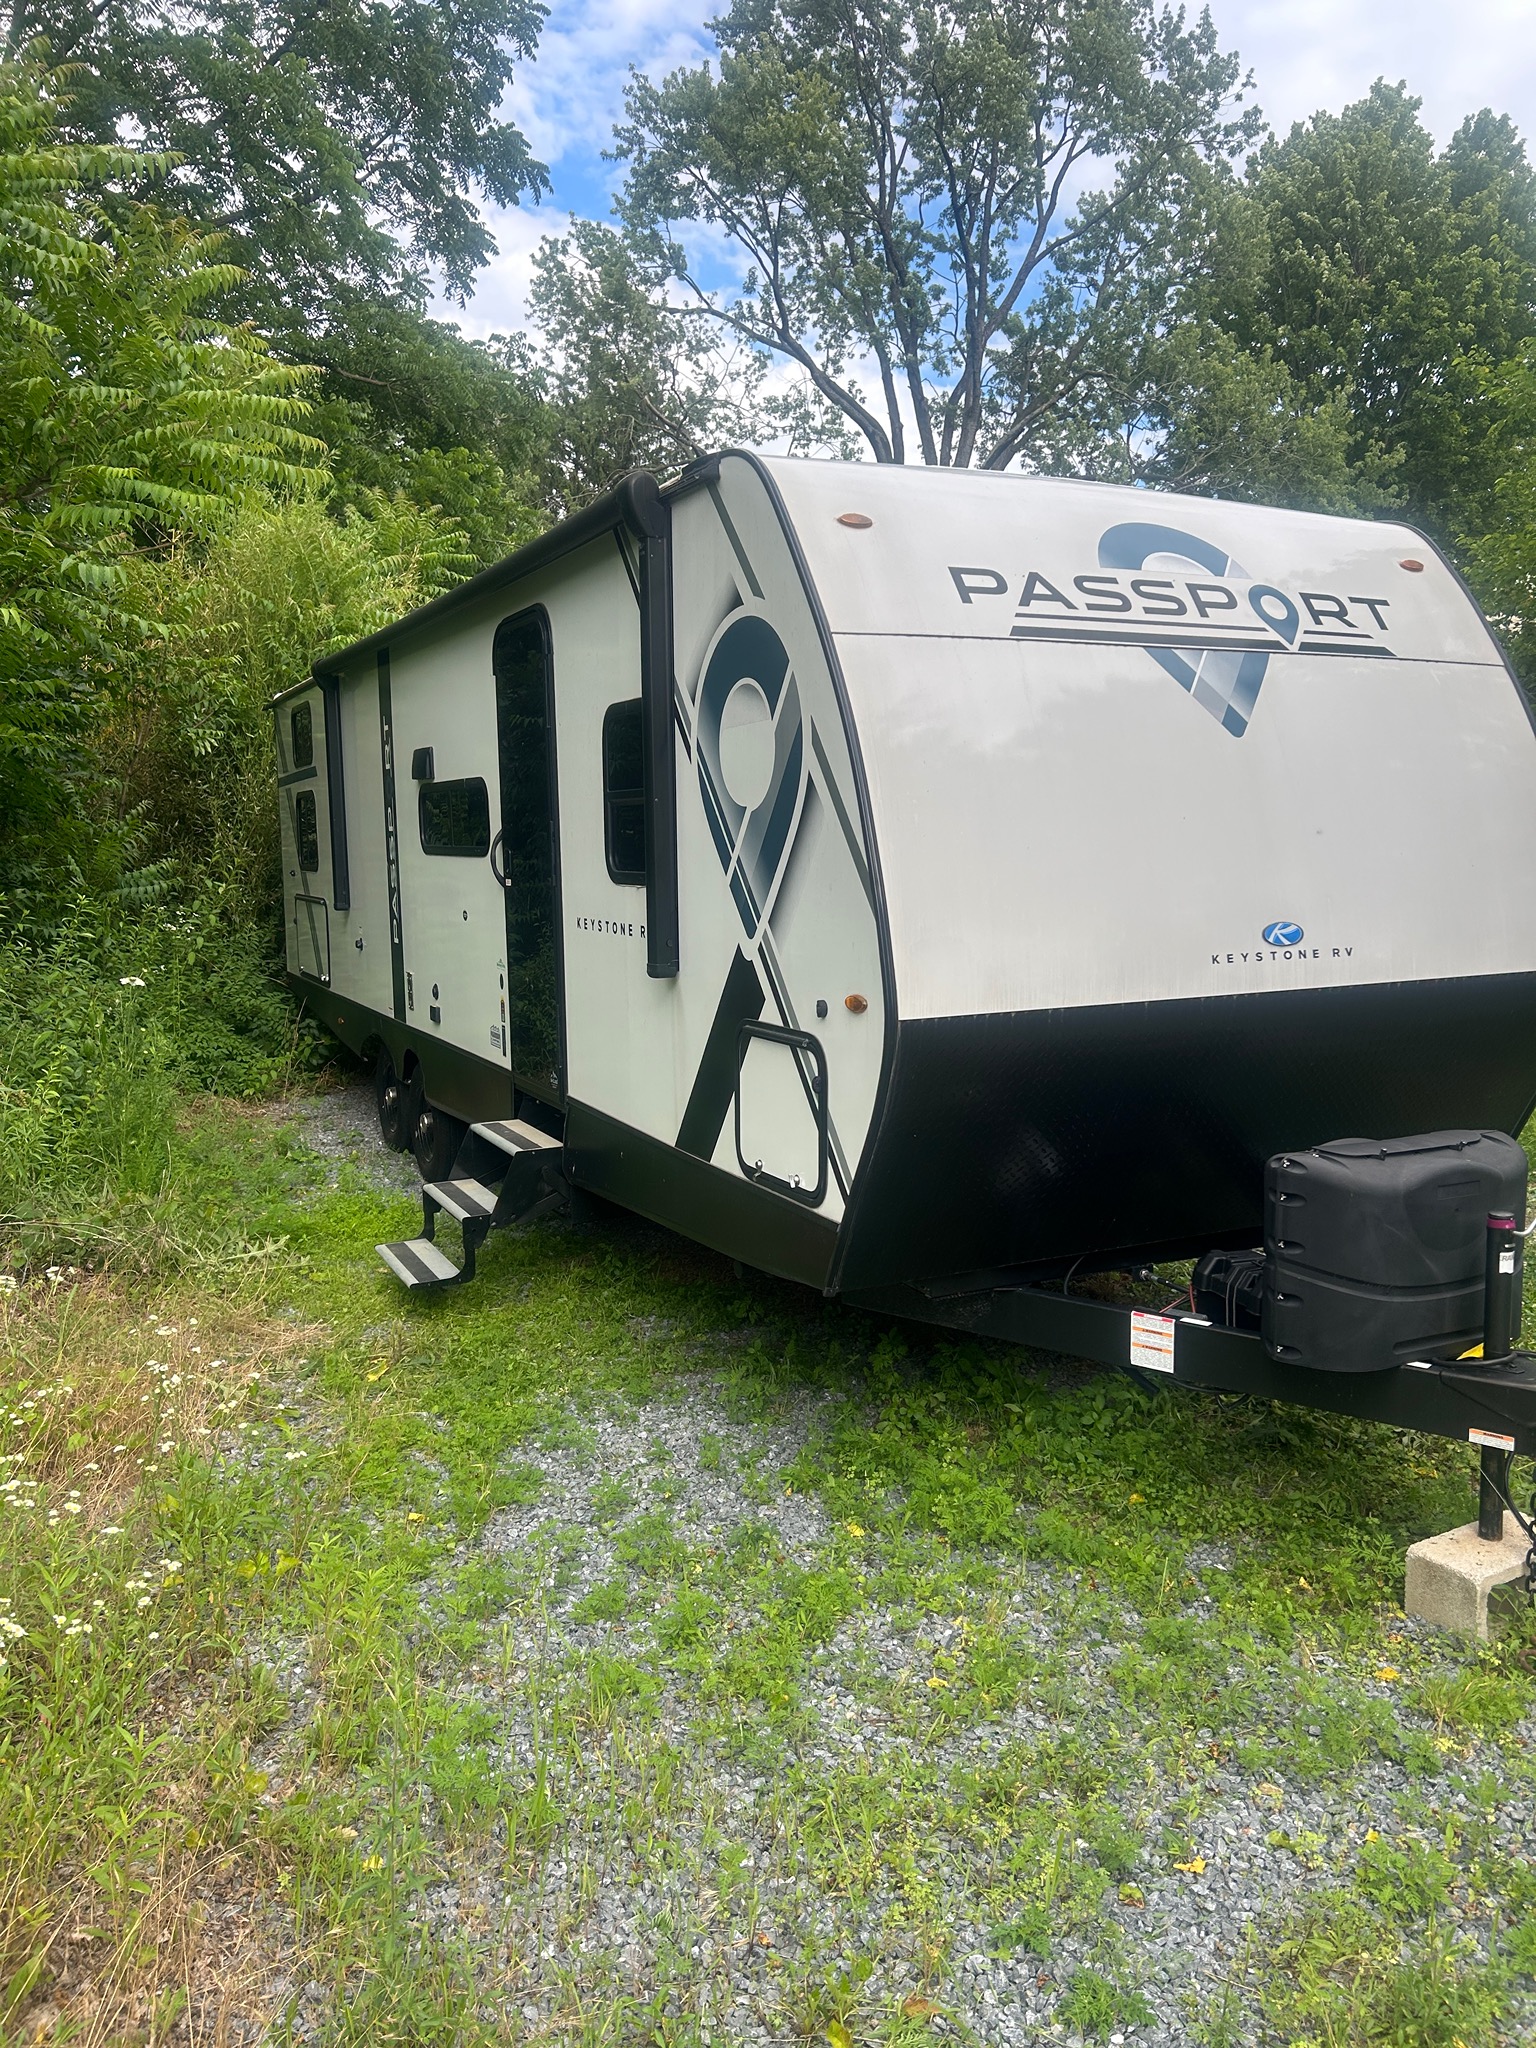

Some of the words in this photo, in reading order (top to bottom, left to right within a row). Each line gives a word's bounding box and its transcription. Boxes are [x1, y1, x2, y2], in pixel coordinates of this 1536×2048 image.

[948, 566, 1391, 646] PASSPORT
[576, 916, 633, 937] KEYSTONE
[1211, 949, 1320, 965] KEYSTONE
[1332, 947, 1353, 958] RV
